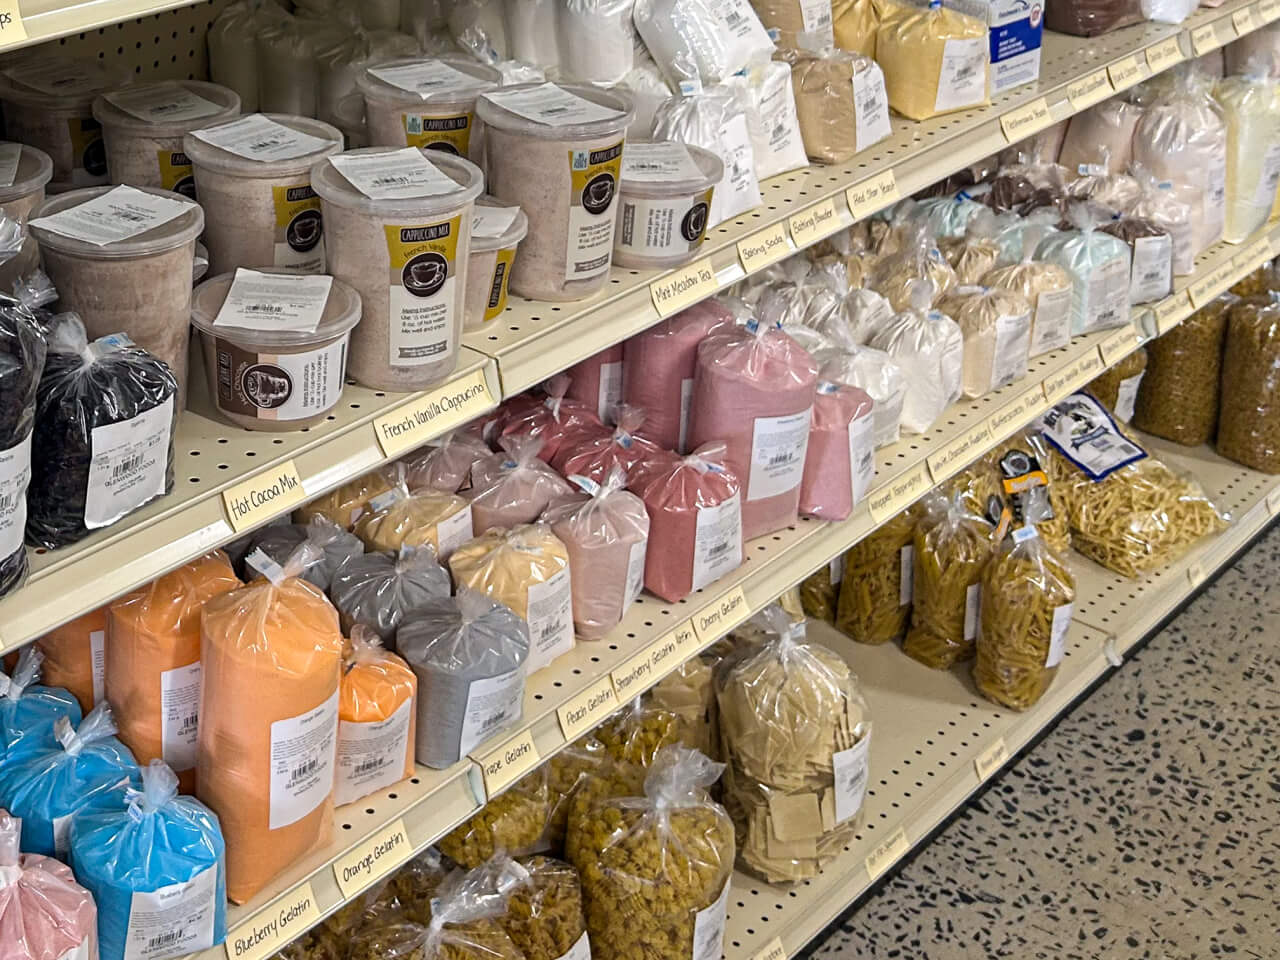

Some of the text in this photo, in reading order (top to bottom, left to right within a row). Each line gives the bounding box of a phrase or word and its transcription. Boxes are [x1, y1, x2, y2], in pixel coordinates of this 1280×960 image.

[402, 223, 450, 242] CAPPUCCINO MIX
[698, 267, 713, 282] Tea
[382, 383, 485, 440] French Vanilla Cappucino
[104, 470, 138, 488] GLENWOOD
[230, 473, 299, 521] Hot Cocoa Mix
[700, 594, 744, 632] Cherry Gelatin
[615, 642, 677, 693] Strawberry Gelatin
[567, 686, 613, 726] Peach Gelatin
[504, 739, 533, 766] Gelatin
[342, 830, 405, 883] Orange Gelatin
[234, 896, 311, 957] Blueberry Gelatin
